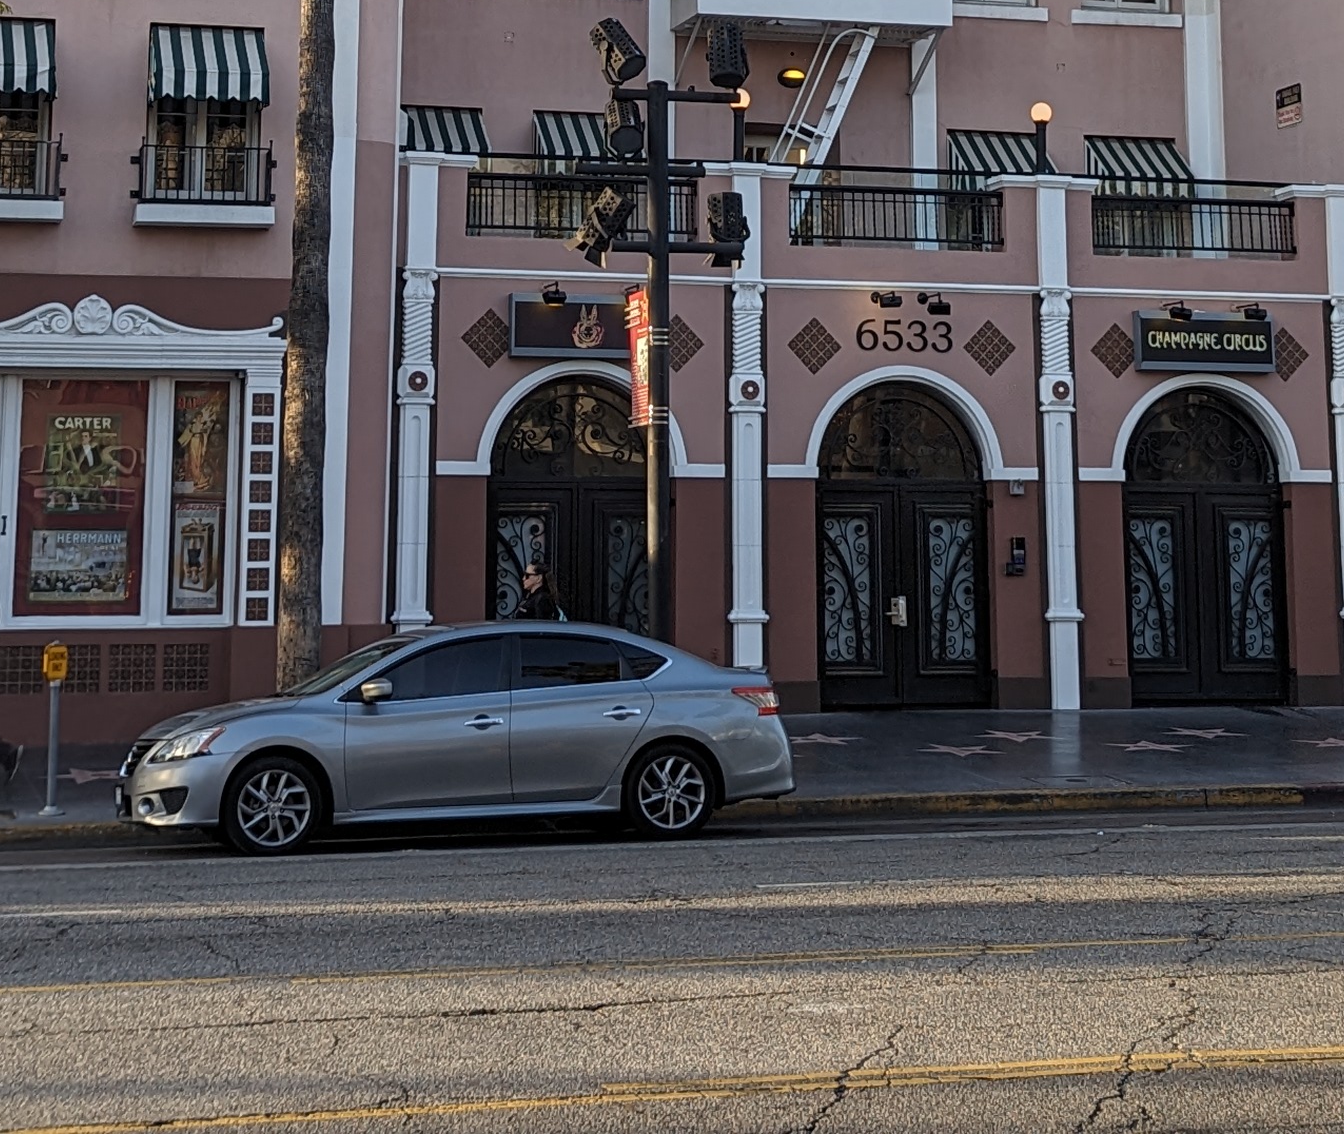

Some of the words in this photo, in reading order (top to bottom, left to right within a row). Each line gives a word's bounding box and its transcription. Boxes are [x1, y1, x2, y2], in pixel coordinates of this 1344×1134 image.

[856, 318, 953, 353] 6533
[1147, 330, 1221, 350] CHAMPAGNE
[1223, 333, 1268, 352] CIRCUS
[54, 417, 112, 430] CARTER
[57, 533, 123, 544] HERRMANN
